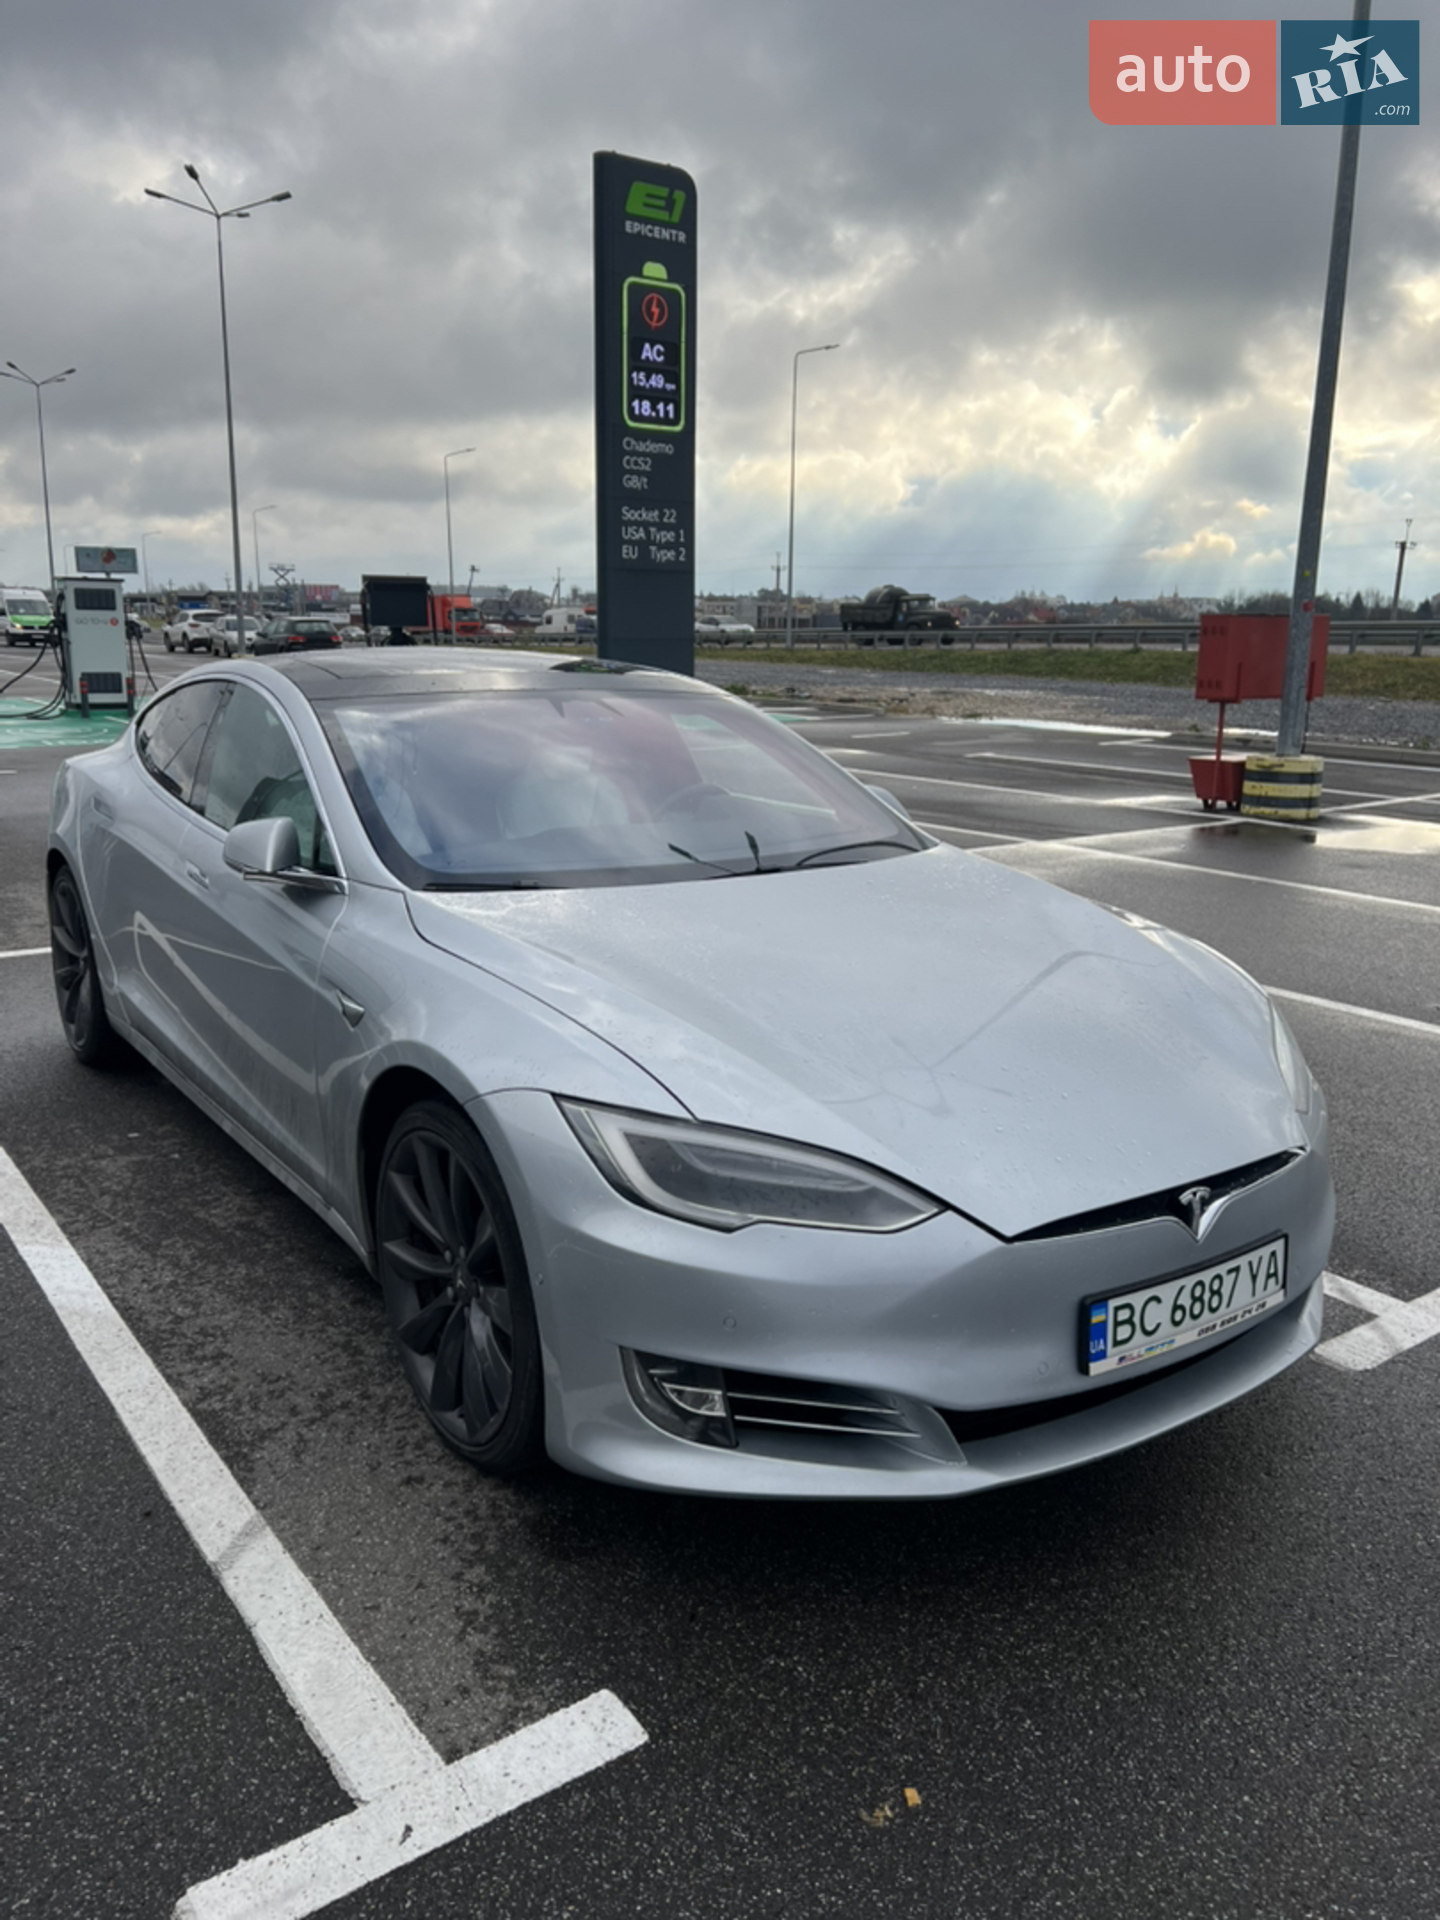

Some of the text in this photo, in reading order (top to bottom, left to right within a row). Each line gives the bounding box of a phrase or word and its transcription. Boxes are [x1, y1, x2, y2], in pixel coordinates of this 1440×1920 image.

[625, 220, 687, 244] EPICENTR
[641, 342, 665, 362] AC
[631, 399, 675, 419] 18.11
[622, 436, 674, 455] Chademo
[622, 455, 652, 471] CCS2
[621, 506, 677, 523] Socket 22
[621, 526, 685, 544] USA Type 1
[621, 545, 686, 562] EU Type 2
[1112, 1295, 1163, 1349] BC
[1170, 1264, 1242, 1328] 6887
[1248, 1249, 1280, 1298] YA
[1089, 1338, 1106, 1354] UA
